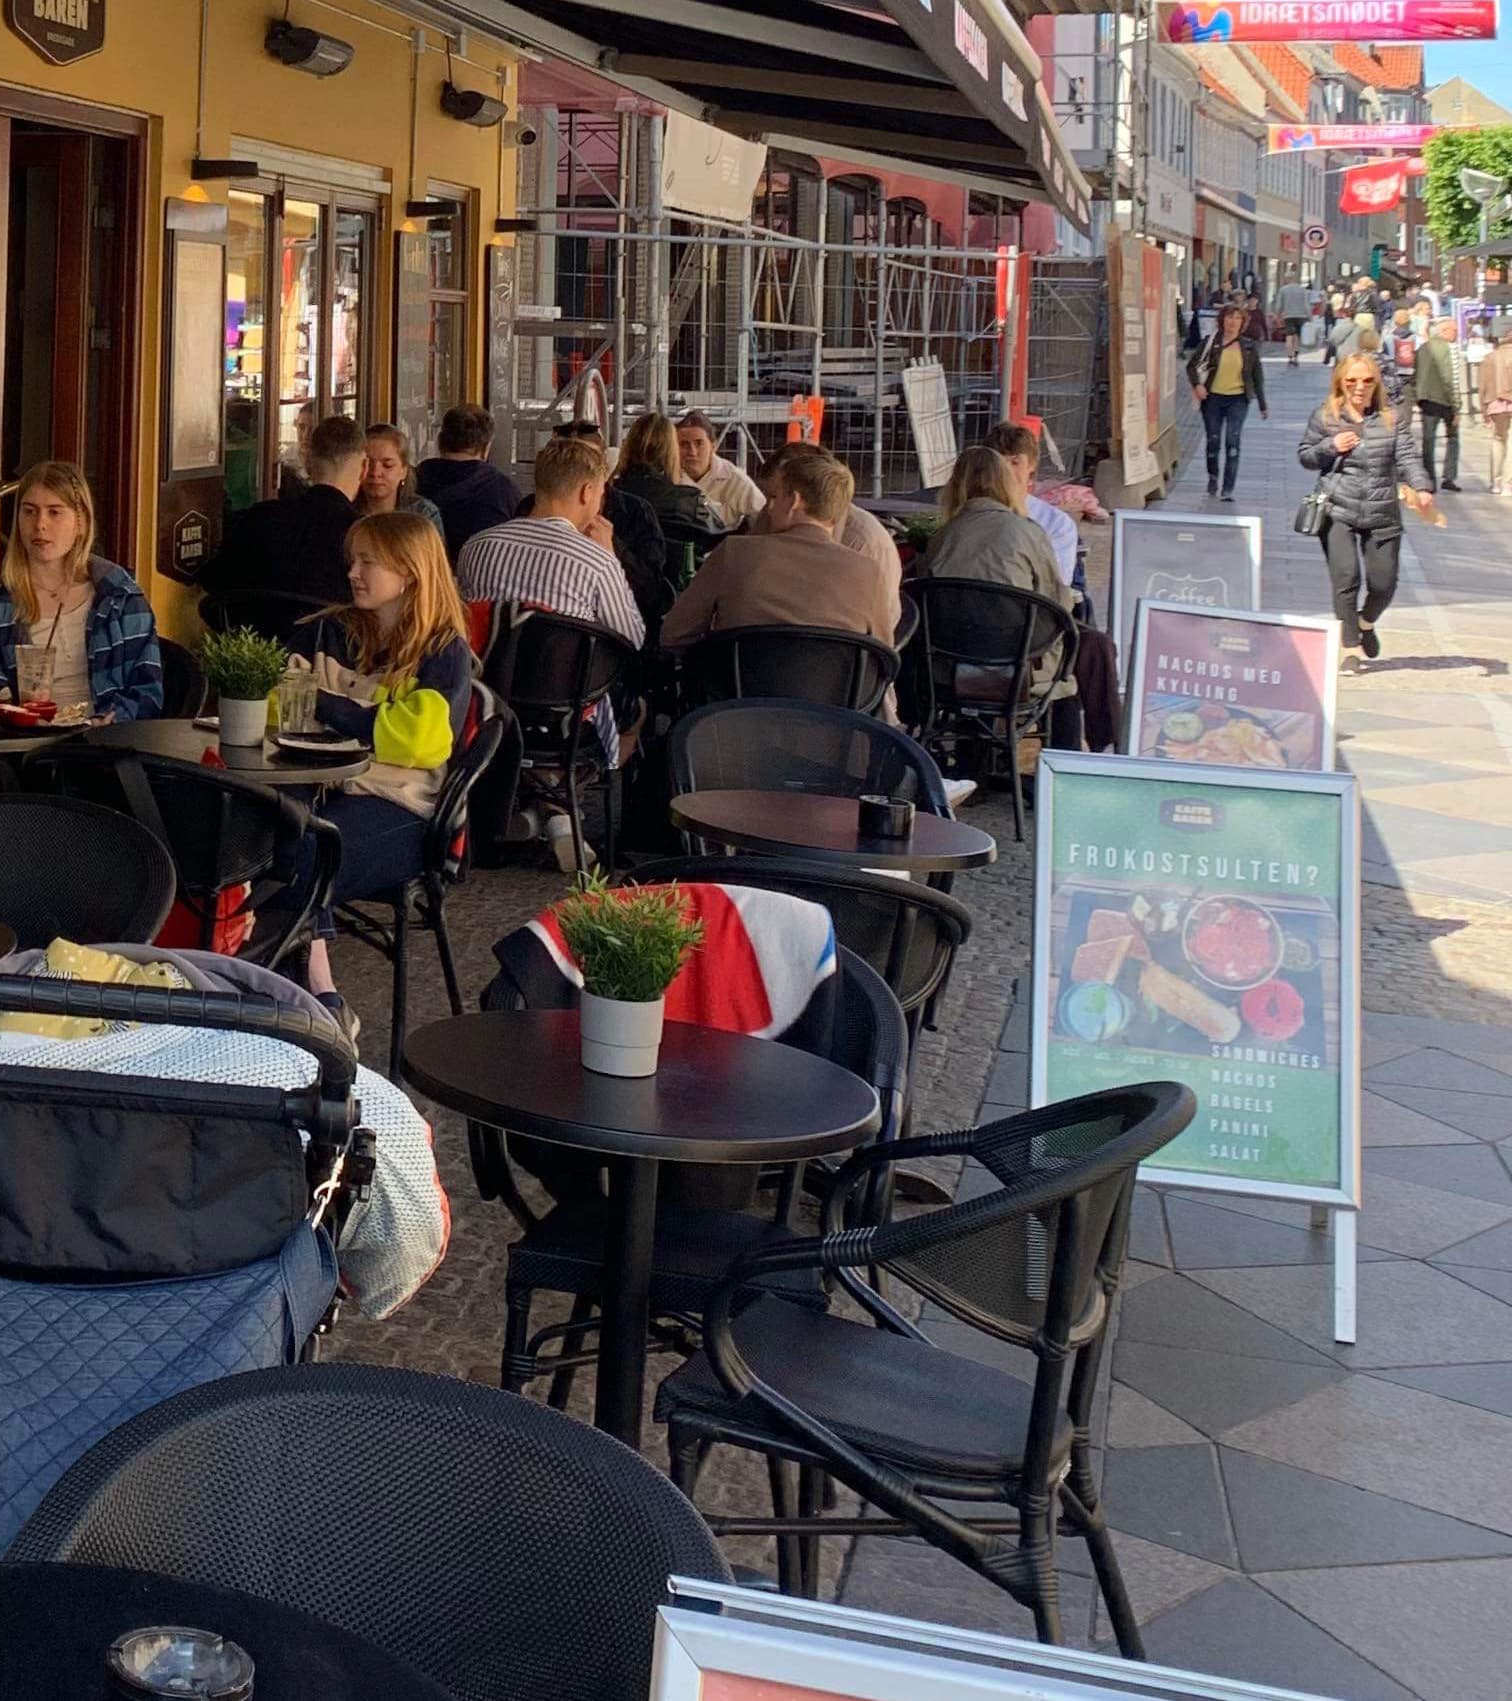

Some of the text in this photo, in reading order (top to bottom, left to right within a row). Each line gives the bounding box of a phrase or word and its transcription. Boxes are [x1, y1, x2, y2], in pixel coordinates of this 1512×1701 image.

[1240, 1, 1406, 24] IDRÆTSMØDET
[1157, 654, 1282, 685] NACHOS MED
[1156, 676, 1239, 702] KYLLING
[1068, 843, 1321, 886] FROKOSTSULTEN?
[1211, 1044, 1321, 1069] SANDWICHES
[1211, 1069, 1277, 1089] NACHOS
[1209, 1094, 1274, 1114] BAGELS
[1209, 1118, 1269, 1138] PANINI
[1209, 1143, 1261, 1162] SALAT
